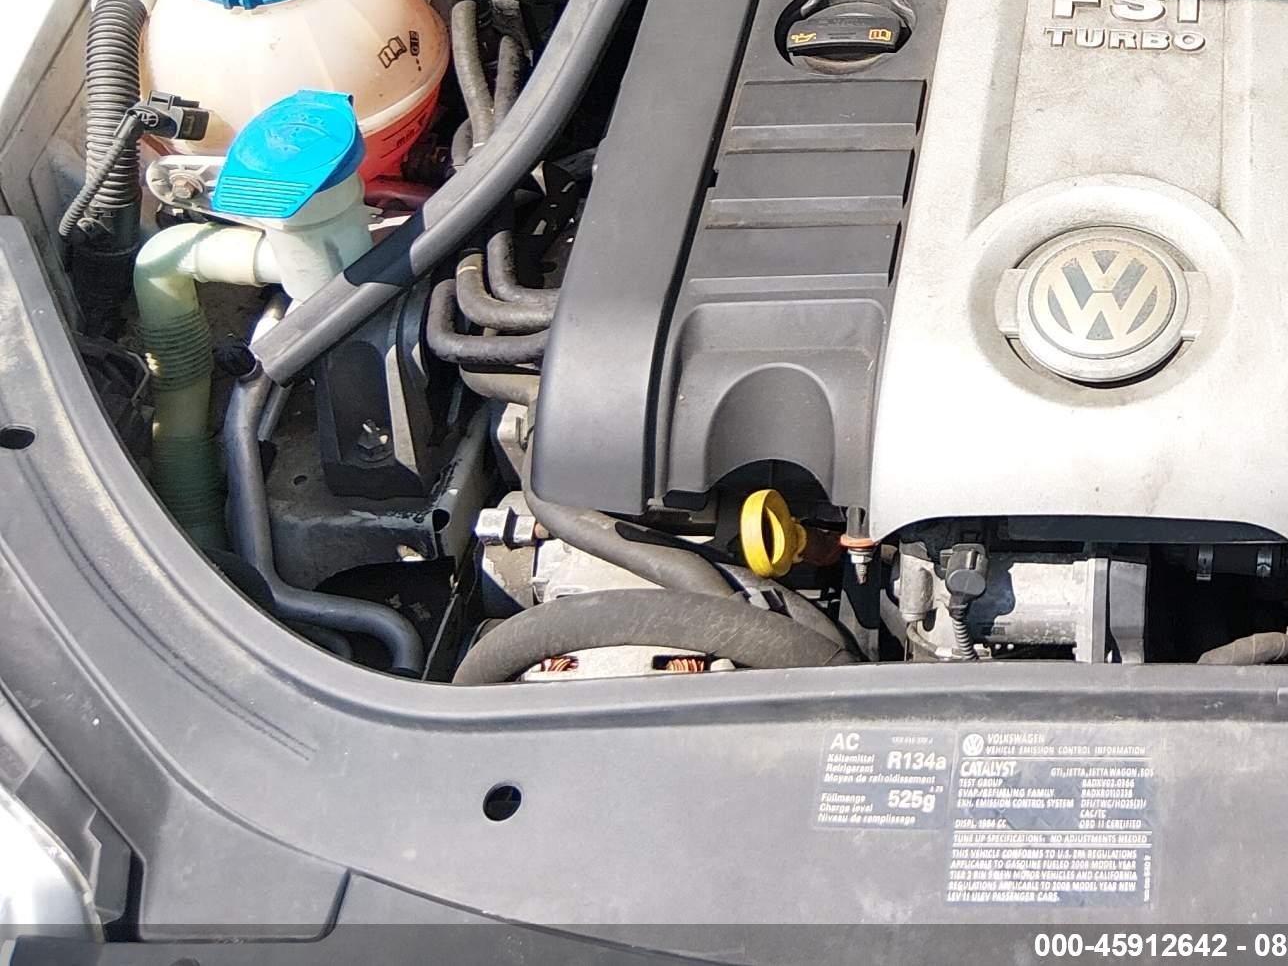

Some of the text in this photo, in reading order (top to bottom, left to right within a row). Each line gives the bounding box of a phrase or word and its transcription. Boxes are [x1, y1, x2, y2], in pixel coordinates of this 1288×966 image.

[1046, 26, 1206, 52] TURBO
[830, 732, 860, 751] AC
[987, 734, 1044, 744] VOLKSWAGEN
[986, 746, 1015, 754] VEHICLE
[1058, 746, 1090, 755] CONTROL
[1095, 746, 1145, 755] INFORMATION
[887, 751, 947, 770] R134a
[961, 761, 1016, 776] CATALYST
[856, 774, 867, 783] de
[960, 779, 1003, 788] TEST GROUP
[888, 790, 936, 812] 525g
[1013, 798, 1045, 808] CONTROL
[820, 803, 873, 813] Charge level
[818, 814, 848, 822] Niveau
[850, 814, 861, 823] de
[976, 834, 986, 843] UP
[1050, 834, 1062, 843] NO
[1064, 834, 1116, 843] ADJUSTMENTS
[1045, 850, 1055, 858] TO
[1087, 850, 1137, 858] REGULATIONS
[994, 860, 1004, 869] TO
[1006, 860, 1041, 869] GASOLINE
[1076, 870, 1092, 880] AND
[1041, 881, 1050, 890] TO
